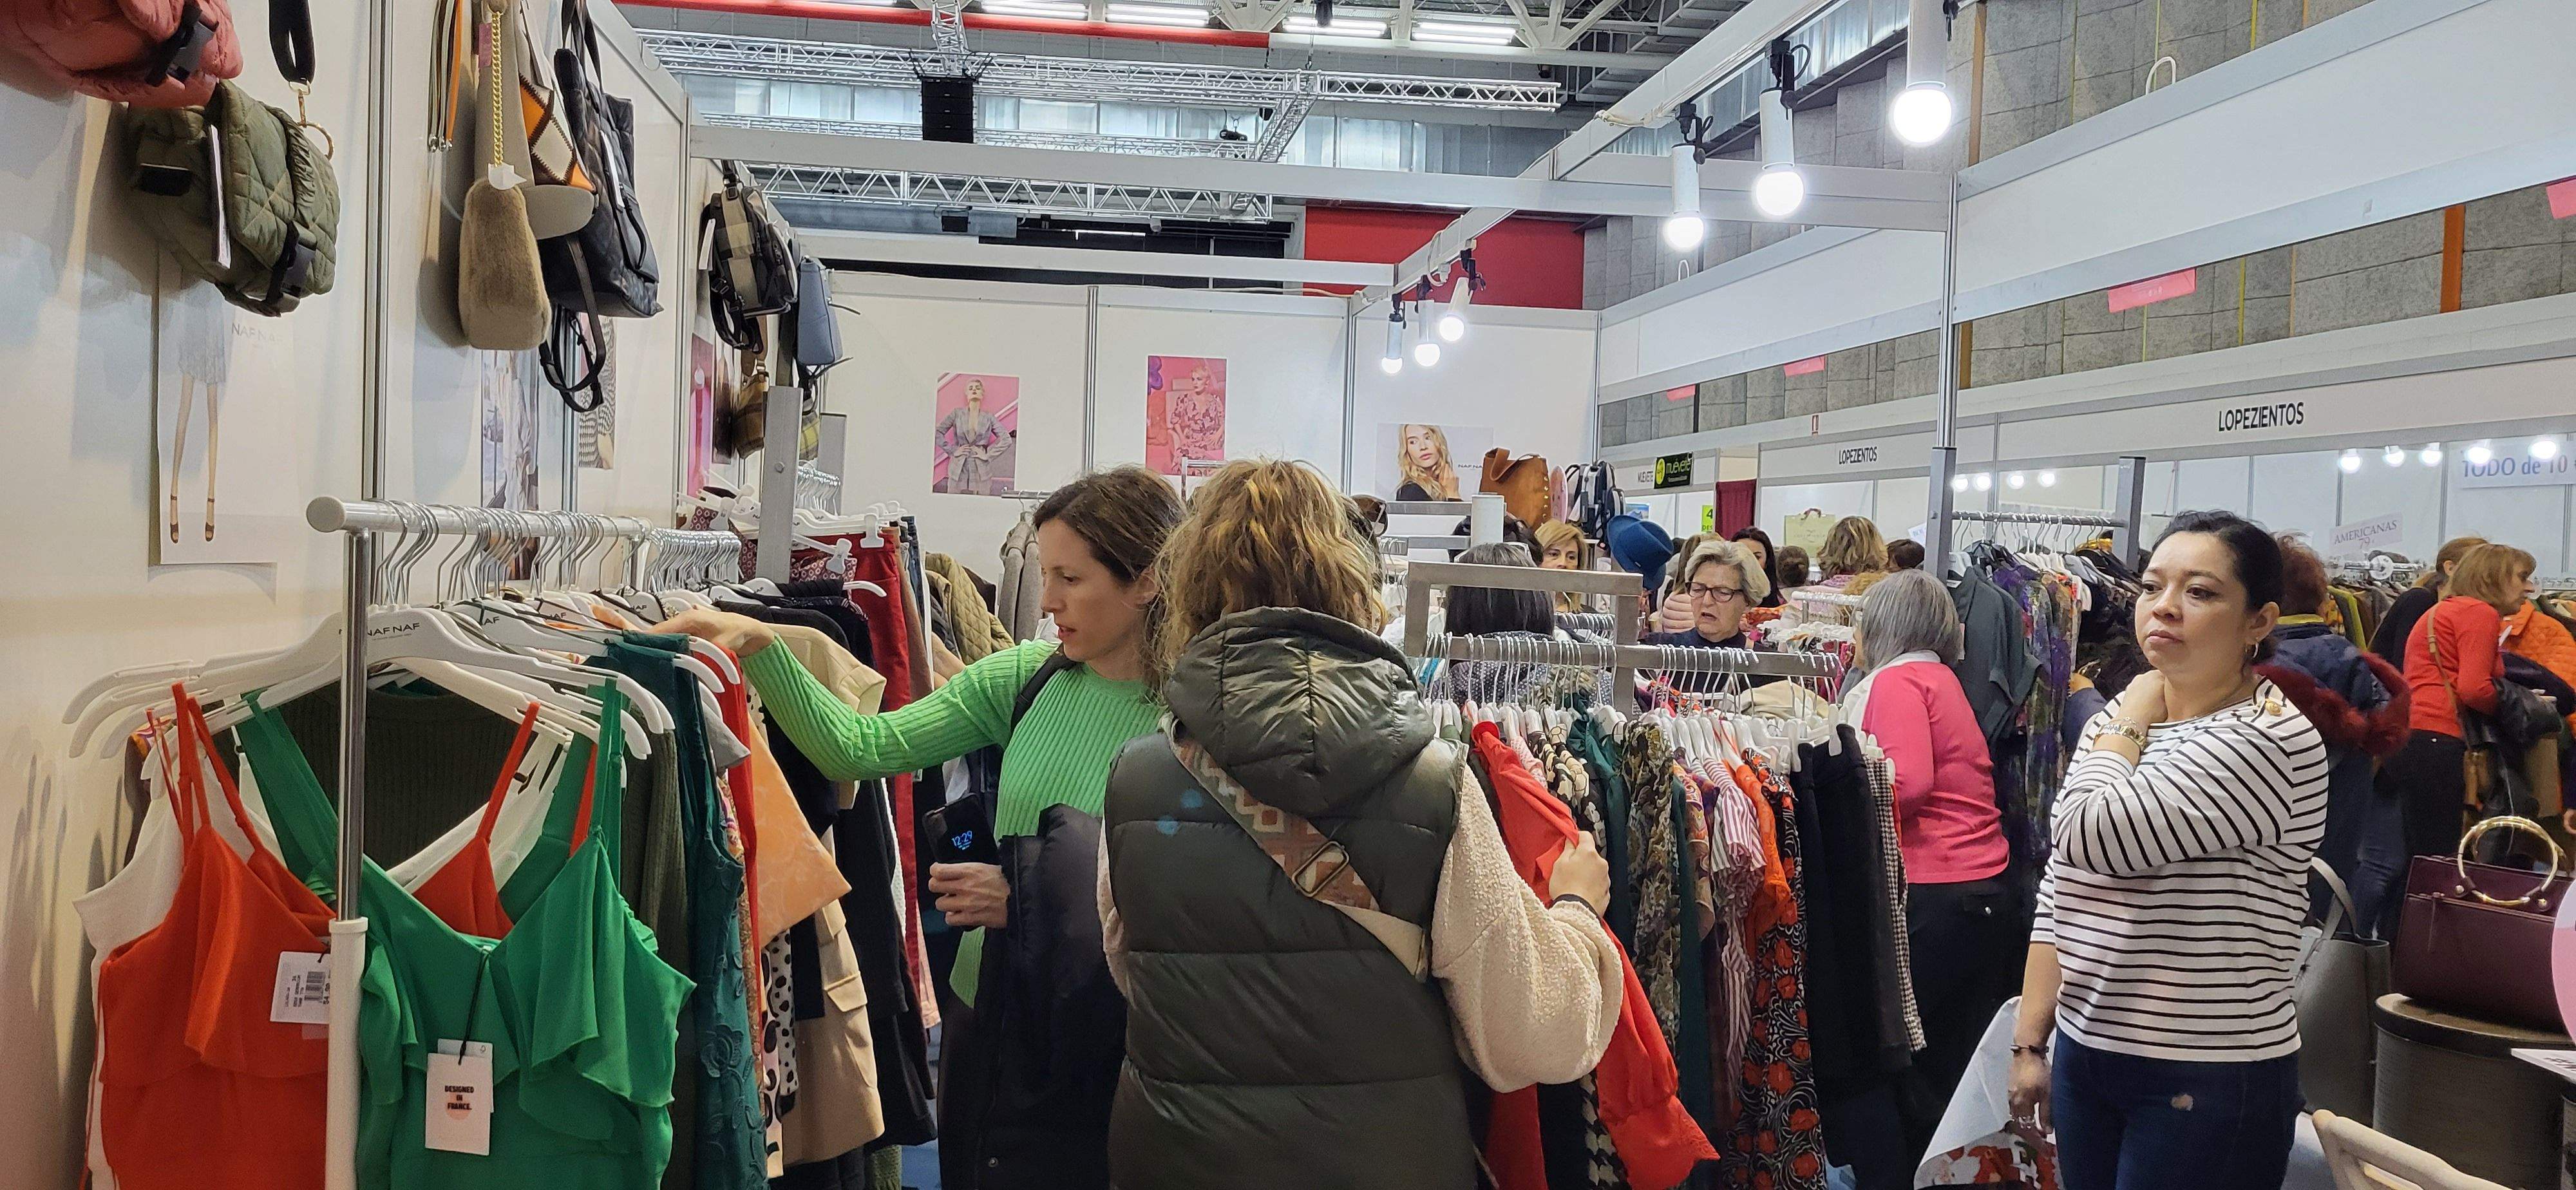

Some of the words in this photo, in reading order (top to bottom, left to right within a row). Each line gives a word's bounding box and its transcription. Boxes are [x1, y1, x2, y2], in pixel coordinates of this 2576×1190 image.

[2219, 402, 2304, 431] LOPEZIENTOS
[2462, 457, 2515, 477] TODO
[2521, 455, 2541, 475] de
[2334, 520, 2397, 545] AMERICANAS
[2358, 536, 2370, 549] 79
[393, 623, 420, 632] NAF
[484, 616, 500, 625] AF
[951, 831, 972, 847] 12:29
[444, 1085, 475, 1093] DESIGNED
